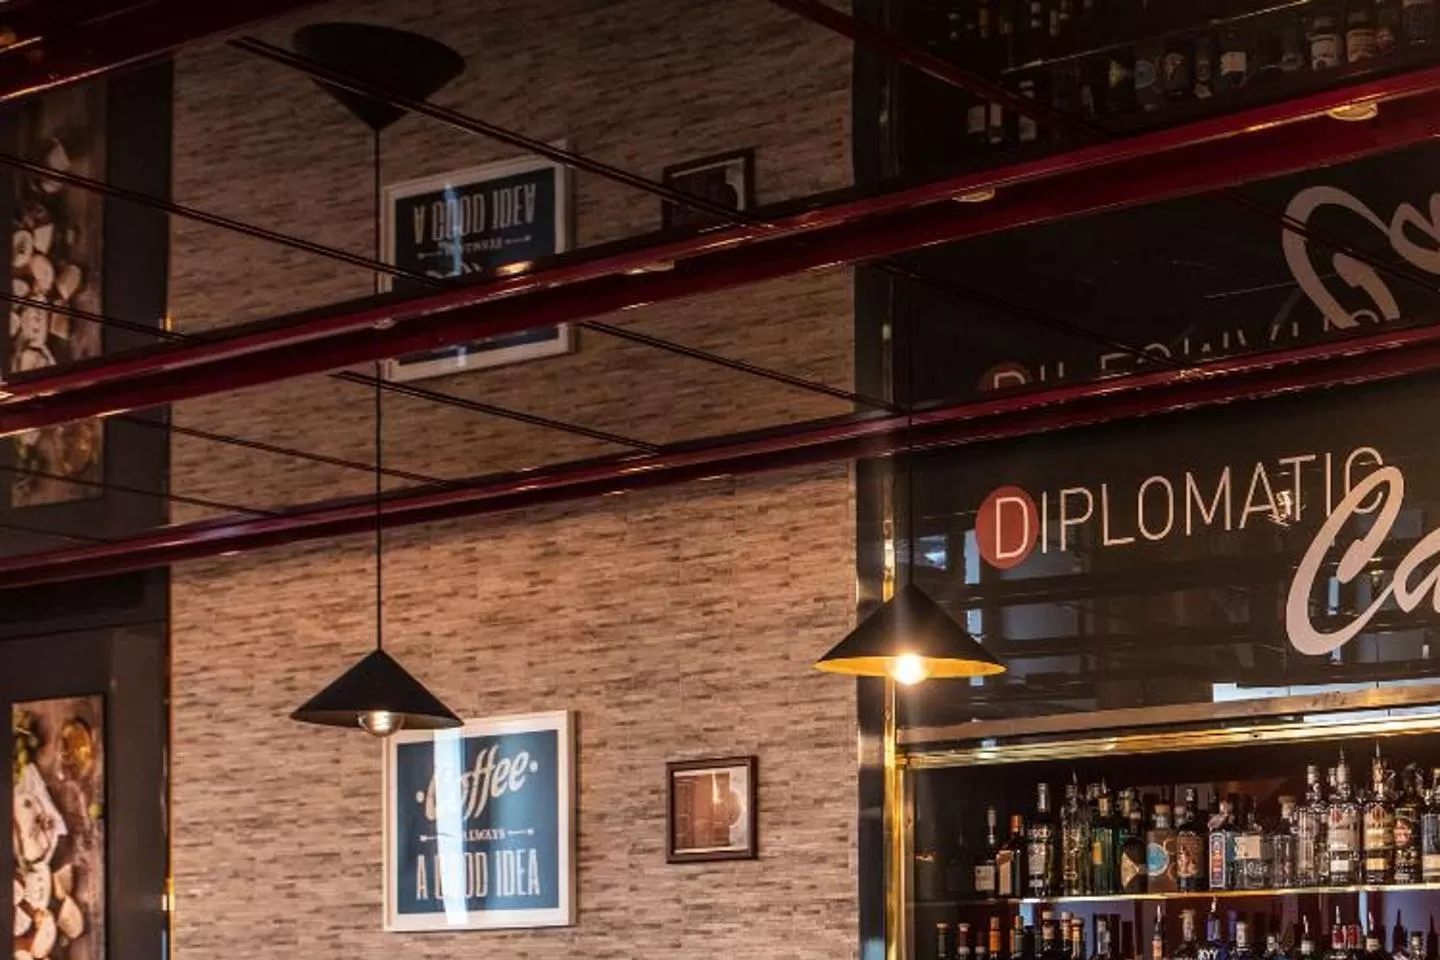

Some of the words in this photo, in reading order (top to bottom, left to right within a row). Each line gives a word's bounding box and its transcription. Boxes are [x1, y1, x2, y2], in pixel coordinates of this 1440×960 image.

[994, 446, 1384, 560] DIPLOMATIC
[416, 854, 428, 900] A
[433, 851, 489, 900] GOD
[496, 848, 541, 897] IDEA
